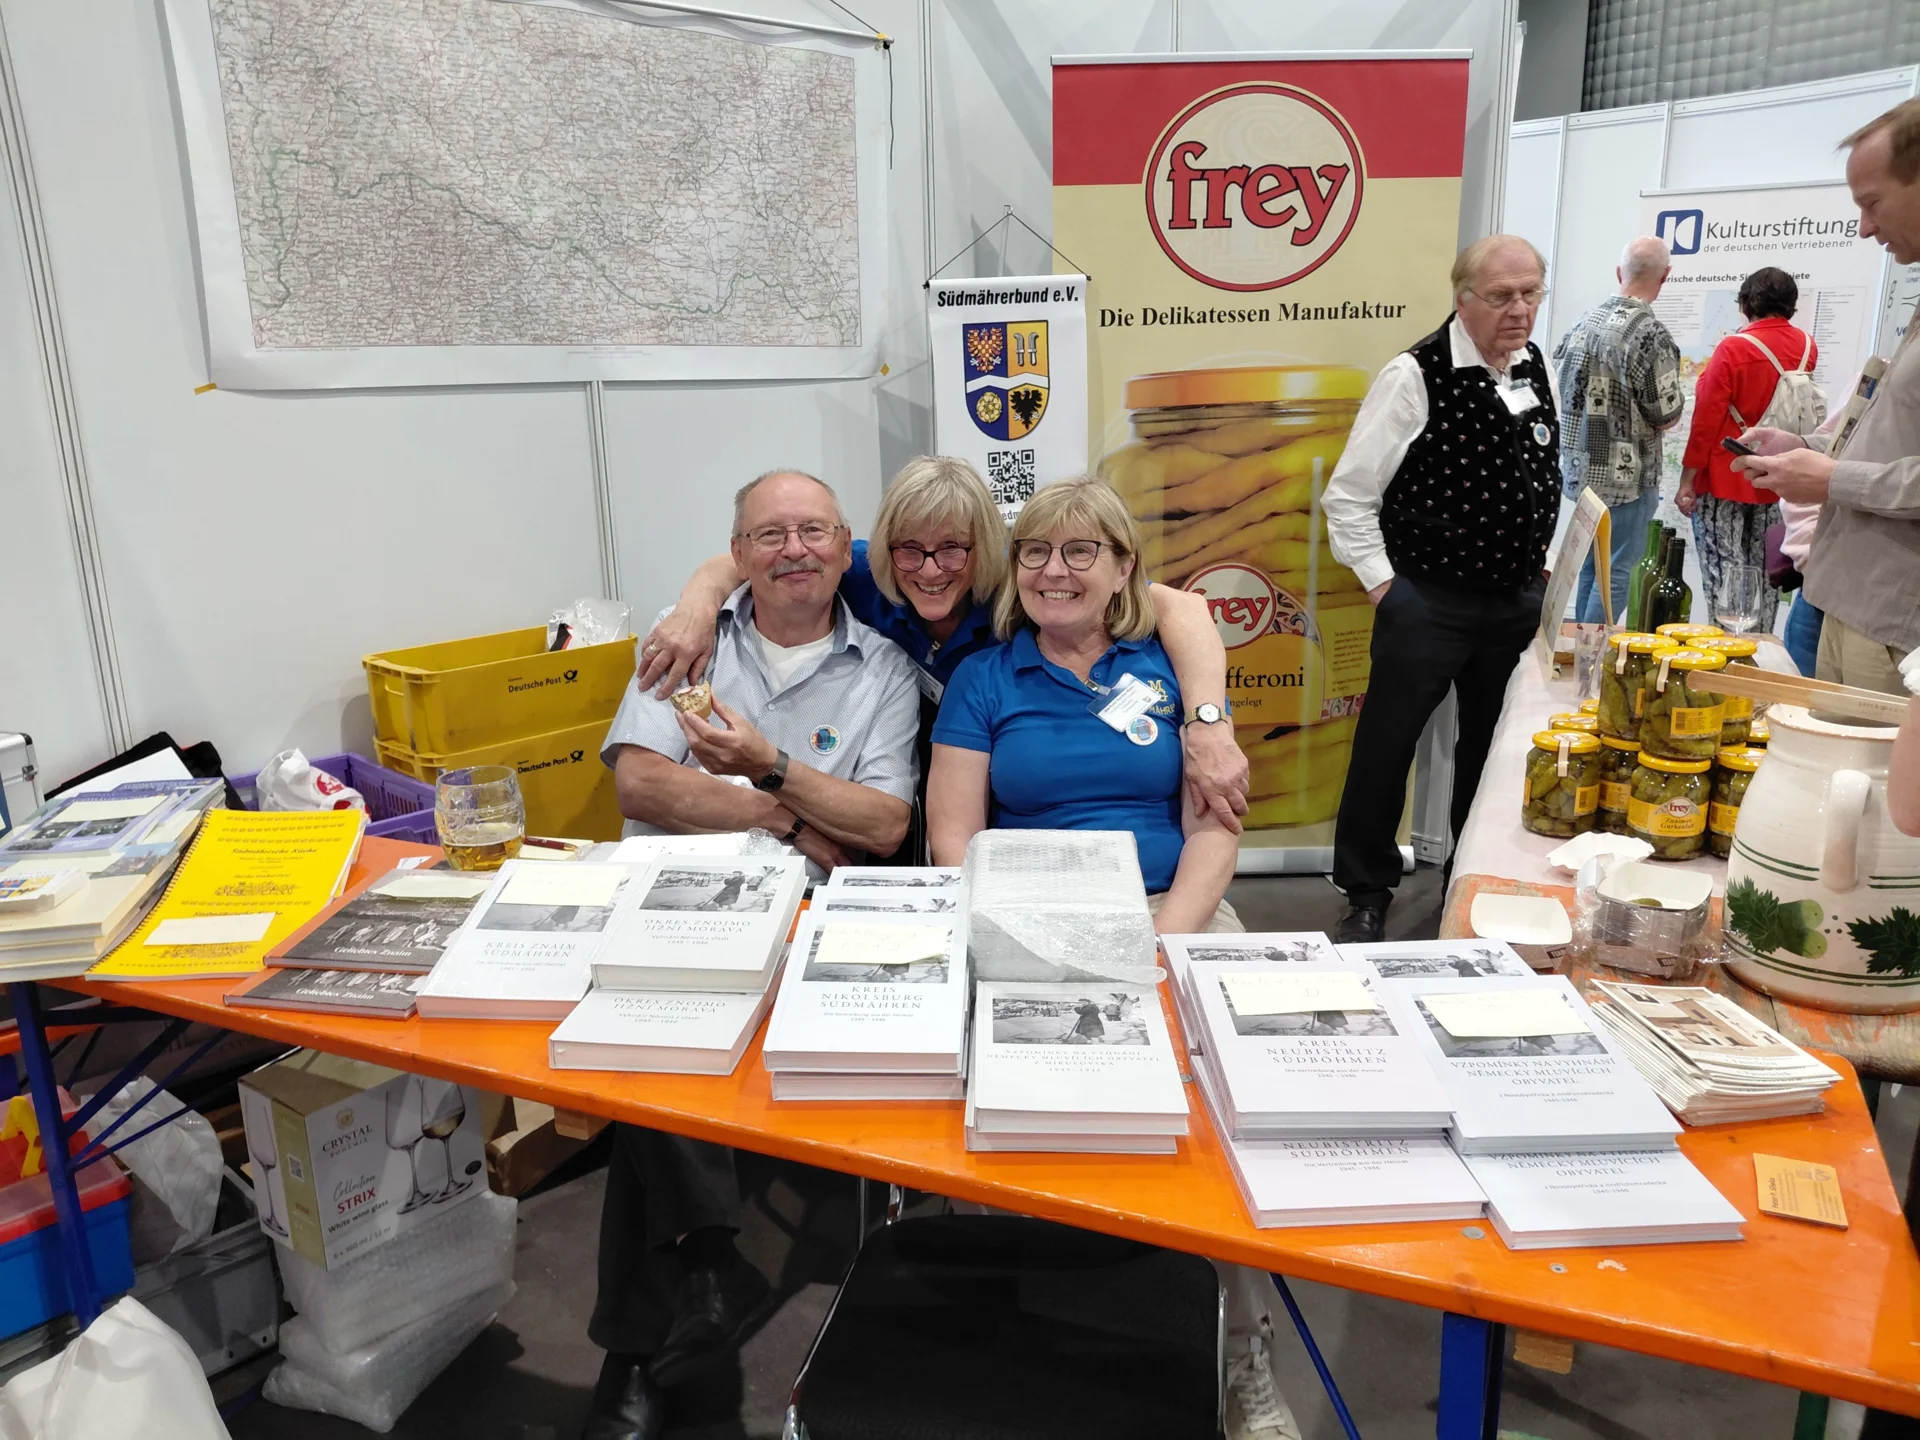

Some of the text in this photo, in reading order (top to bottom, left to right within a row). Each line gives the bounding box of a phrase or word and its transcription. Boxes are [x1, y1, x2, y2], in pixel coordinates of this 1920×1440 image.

[1167, 141, 1350, 246] frey
[1706, 216, 1858, 240] Kulturstiftung
[1704, 238, 1853, 253] der deutschen Vertriebenen
[1666, 274, 1694, 283] rische
[1695, 273, 1738, 282] deutsche
[937, 286, 1079, 308] Südmährerbund e.V.
[1099, 300, 1407, 328] Die Delikatessen Manufaktur
[1225, 666, 1304, 689] fferoni
[508, 676, 561, 693] Deutsche Post
[1229, 697, 1262, 708] ngelegt
[517, 761, 551, 774] Deutsche
[553, 757, 568, 767] Post
[1669, 803, 1690, 814] frey
[694, 919, 751, 927] ZNOJMO
[687, 925, 743, 933] MORAVA
[486, 941, 577, 950] KREIS ZNAIM
[380, 947, 412, 957] Znaim
[483, 949, 571, 957] SÜDMÄHREN
[821, 993, 923, 1001] NIKOLSBURG
[666, 999, 726, 1007] ZNOJMO
[820, 1001, 922, 1009] SÜDMÄHREN
[657, 1005, 717, 1013] MORAVA
[1272, 1055, 1387, 1064] SÜDBÖHMEN
[1450, 1060, 1530, 1069] VZPOMÍNKY
[1555, 1057, 1616, 1066] VYHNÁNÍ
[1467, 1066, 1612, 1077] NĚMECKY MLUVÍCÍCH
[1512, 1077, 1579, 1085] OBYVATEL
[322, 1124, 373, 1152] CRYSTAL
[1282, 1139, 1409, 1150] NEUBISTRITZ
[1290, 1147, 1410, 1158] SÜDBÖHMEN
[1508, 1156, 1661, 1169] NĚMECKY MLUVÍCÍCH
[1556, 1167, 1628, 1177] OBYVATEL
[333, 1174, 376, 1202] Collection
[337, 1187, 376, 1215] STRIX
[328, 1200, 389, 1234] White wine glass
